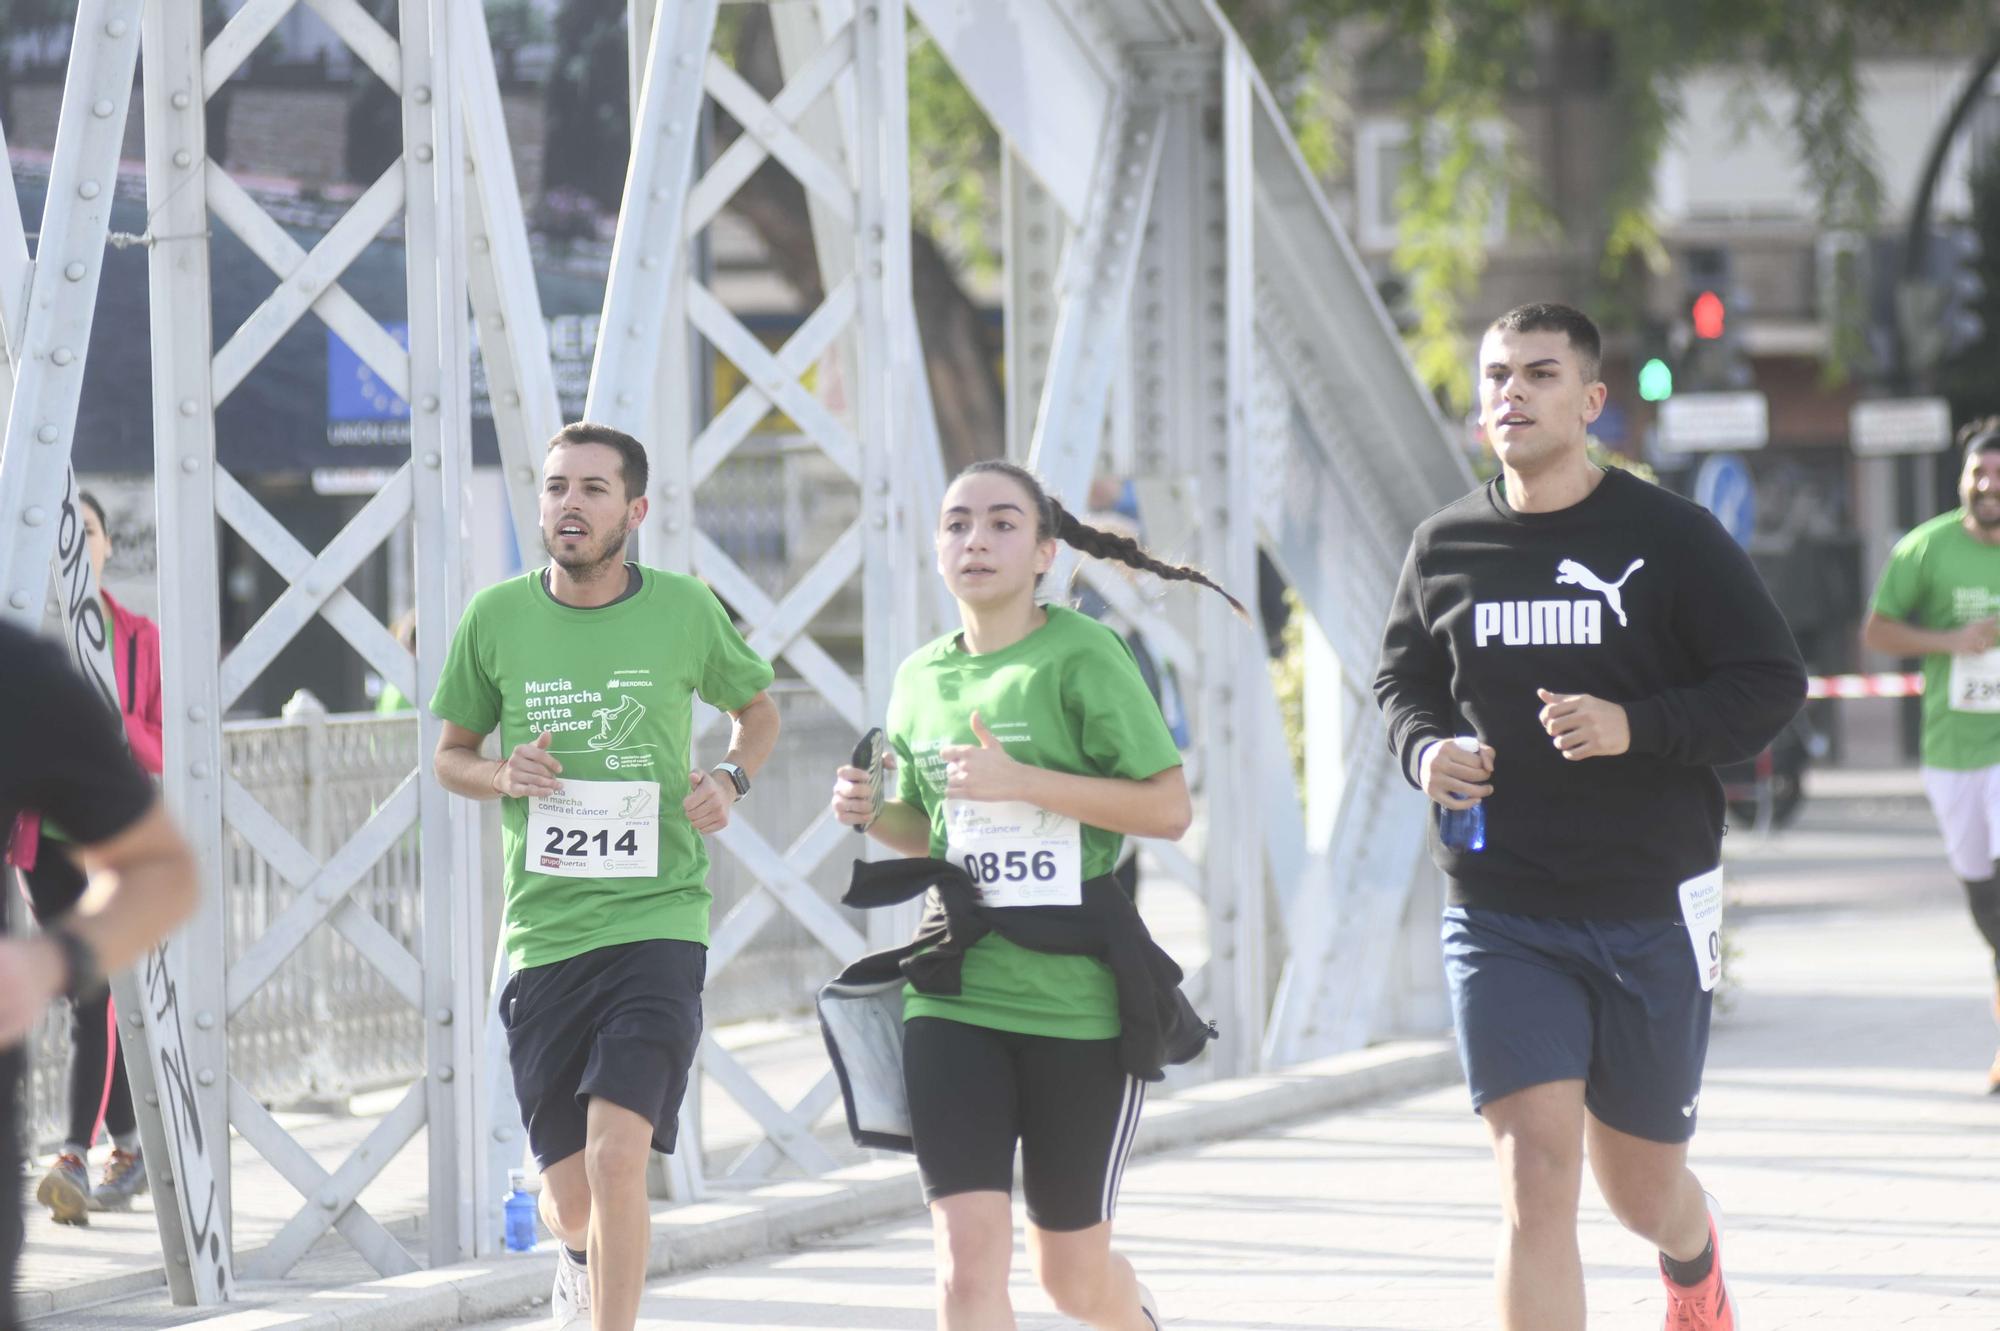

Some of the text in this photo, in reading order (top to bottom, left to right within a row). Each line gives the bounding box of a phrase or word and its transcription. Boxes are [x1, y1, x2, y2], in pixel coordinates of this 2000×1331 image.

[1475, 600, 1601, 647] PUMA
[525, 678, 572, 694] Murcia
[620, 680, 653, 688] IBERDROLA
[525, 690, 602, 708] en marcha
[527, 707, 572, 720] contra
[529, 719, 594, 734] el cáncer
[550, 795, 583, 807] marcha
[538, 803, 609, 816] contra el cáncer
[544, 826, 638, 857] 2214
[963, 850, 1057, 884] 0856
[1709, 931, 1721, 962] 0
